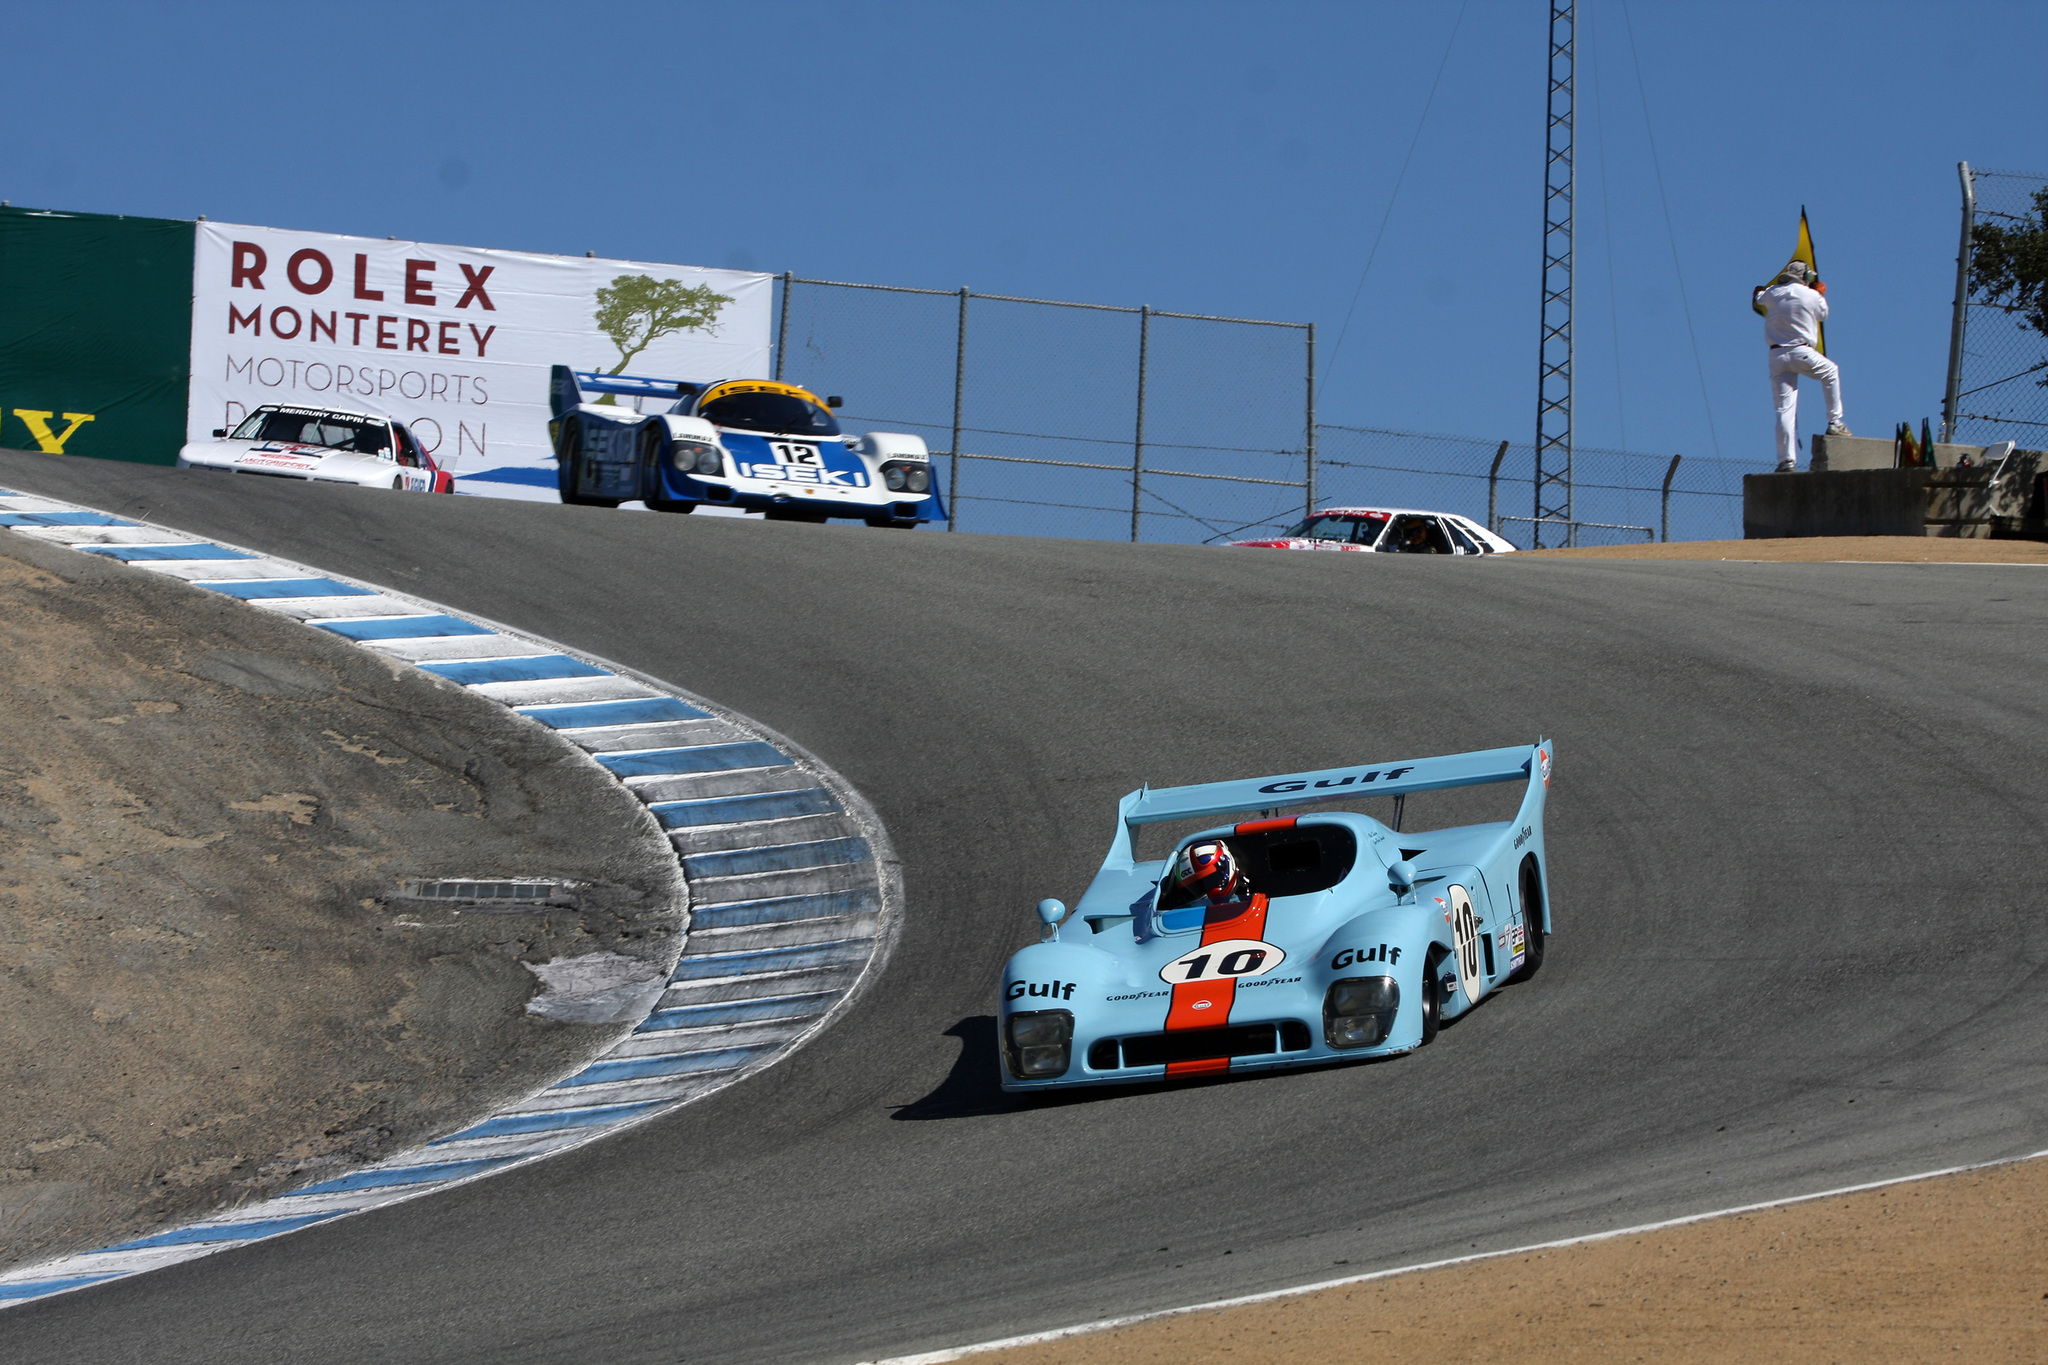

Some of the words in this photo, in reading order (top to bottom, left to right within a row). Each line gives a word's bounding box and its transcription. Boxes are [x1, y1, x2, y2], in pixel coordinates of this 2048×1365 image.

[231, 241, 496, 311] ROLEX
[229, 301, 496, 357] MONTEREY
[226, 354, 488, 405] MOTORSPORTS
[279, 407, 330, 418] MERCURY
[331, 413, 364, 424] CAPRI
[0, 407, 95, 455] Y
[777, 443, 817, 465] 12
[739, 461, 867, 487] ISEKI
[1258, 766, 1415, 794] Gulf
[1455, 901, 1478, 981] 10
[1178, 949, 1267, 980] 10
[1331, 943, 1402, 970] Gulf
[1005, 979, 1077, 1002] Gulf
